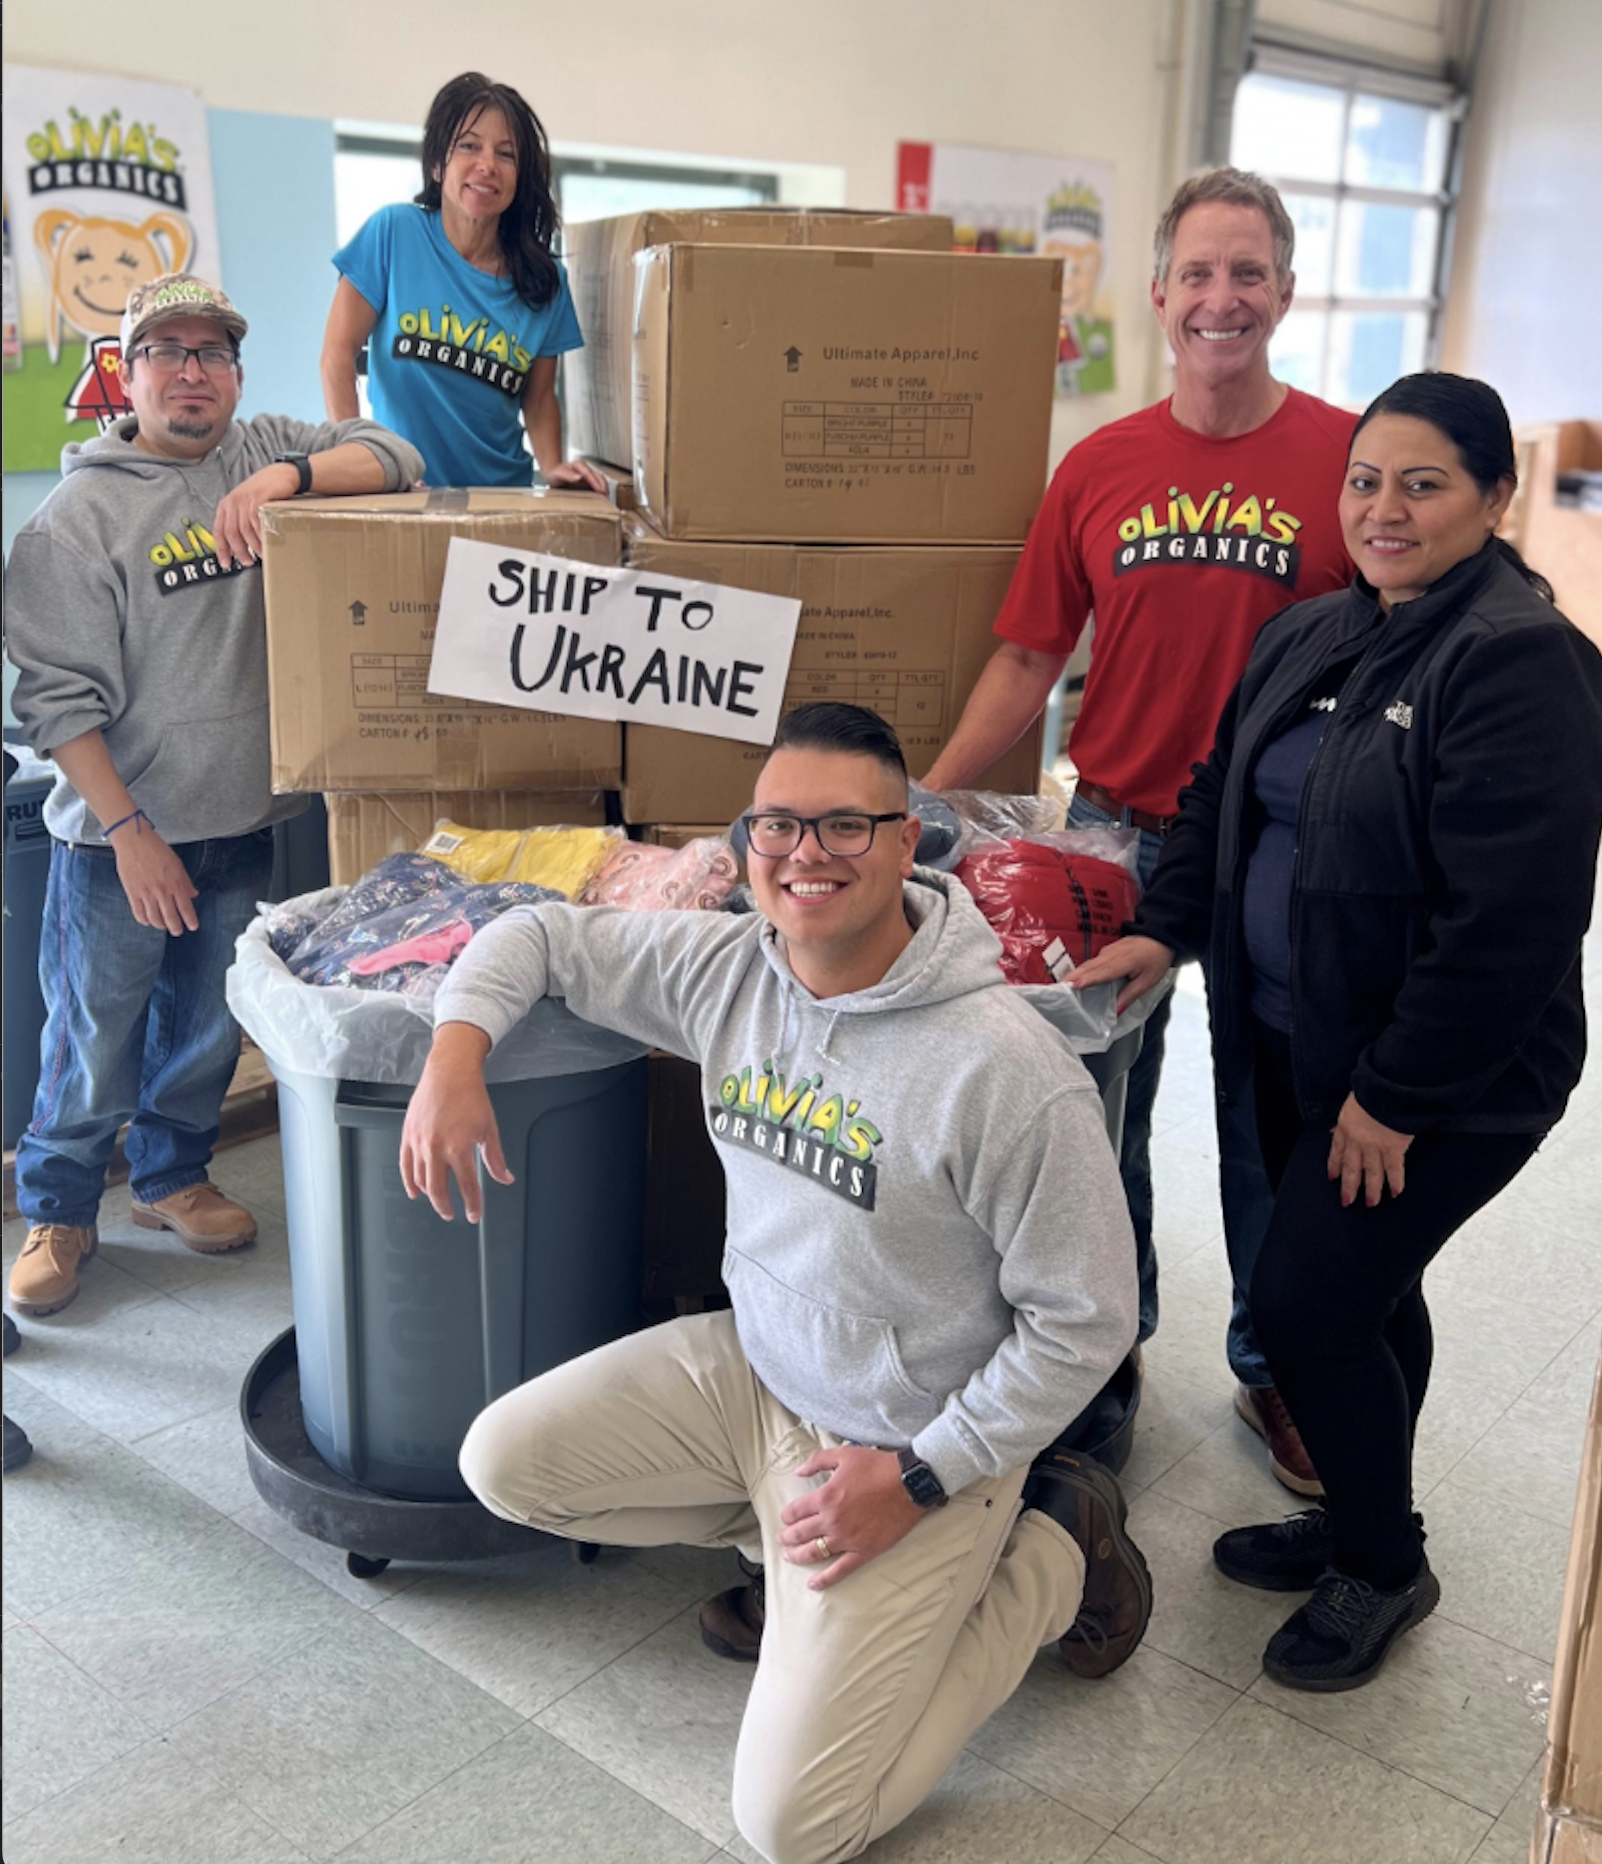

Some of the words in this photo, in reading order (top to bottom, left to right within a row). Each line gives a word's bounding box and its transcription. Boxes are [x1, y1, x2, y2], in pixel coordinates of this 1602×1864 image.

[34, 162, 178, 203] ORGANICS
[399, 338, 523, 394] ORGANICS
[823, 347, 888, 360] Ultimate
[850, 377, 878, 388] MADE
[883, 377, 894, 388] IN
[898, 377, 927, 388] CHINA
[1121, 536, 1290, 576] ORGANICS
[389, 601, 439, 614] Ultima
[488, 559, 607, 615] SHIP
[635, 586, 714, 632] TO
[510, 623, 764, 717] UKRAINE
[714, 1112, 864, 1197] ORGANICS
